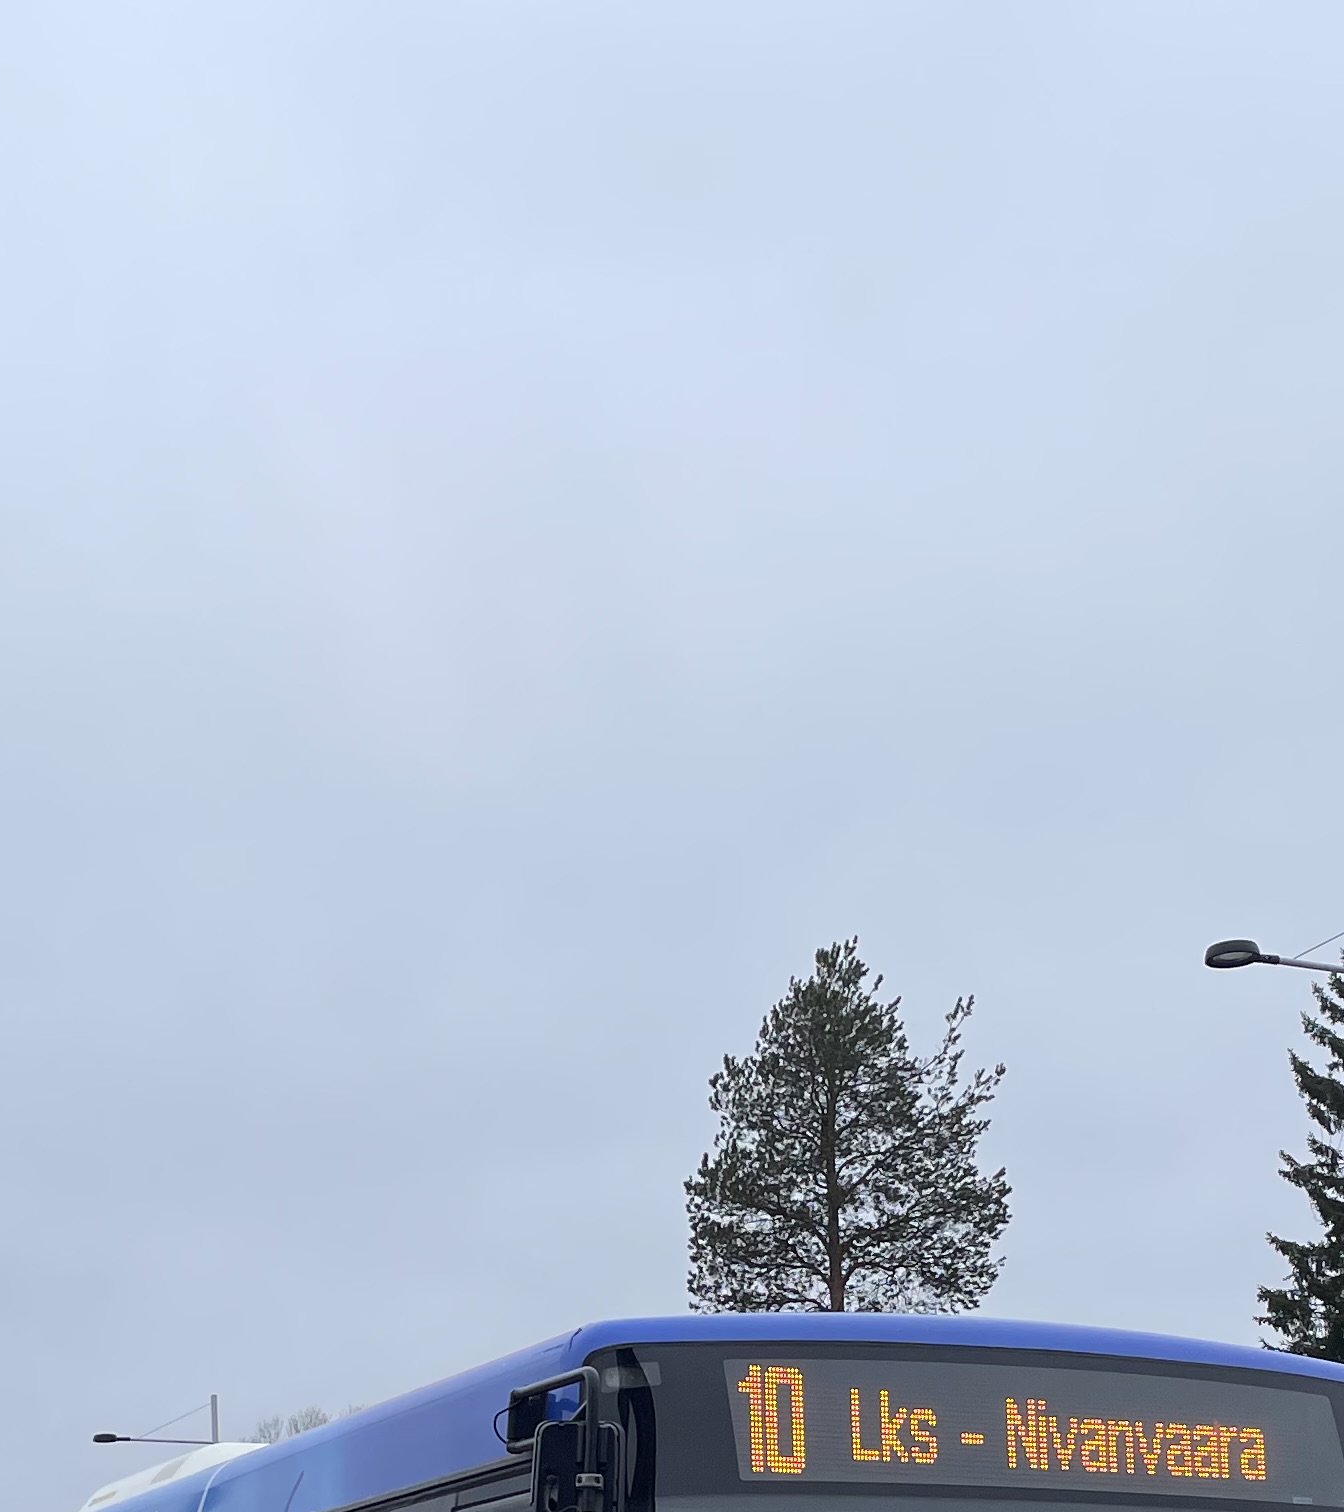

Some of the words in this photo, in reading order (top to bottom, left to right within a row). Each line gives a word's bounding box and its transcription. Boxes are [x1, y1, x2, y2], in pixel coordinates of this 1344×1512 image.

[737, 1364, 806, 1474] 10
[849, 1387, 938, 1464] Lks
[960, 1431, 984, 1445] -
[1005, 1397, 1267, 1481] Nivanvaara
